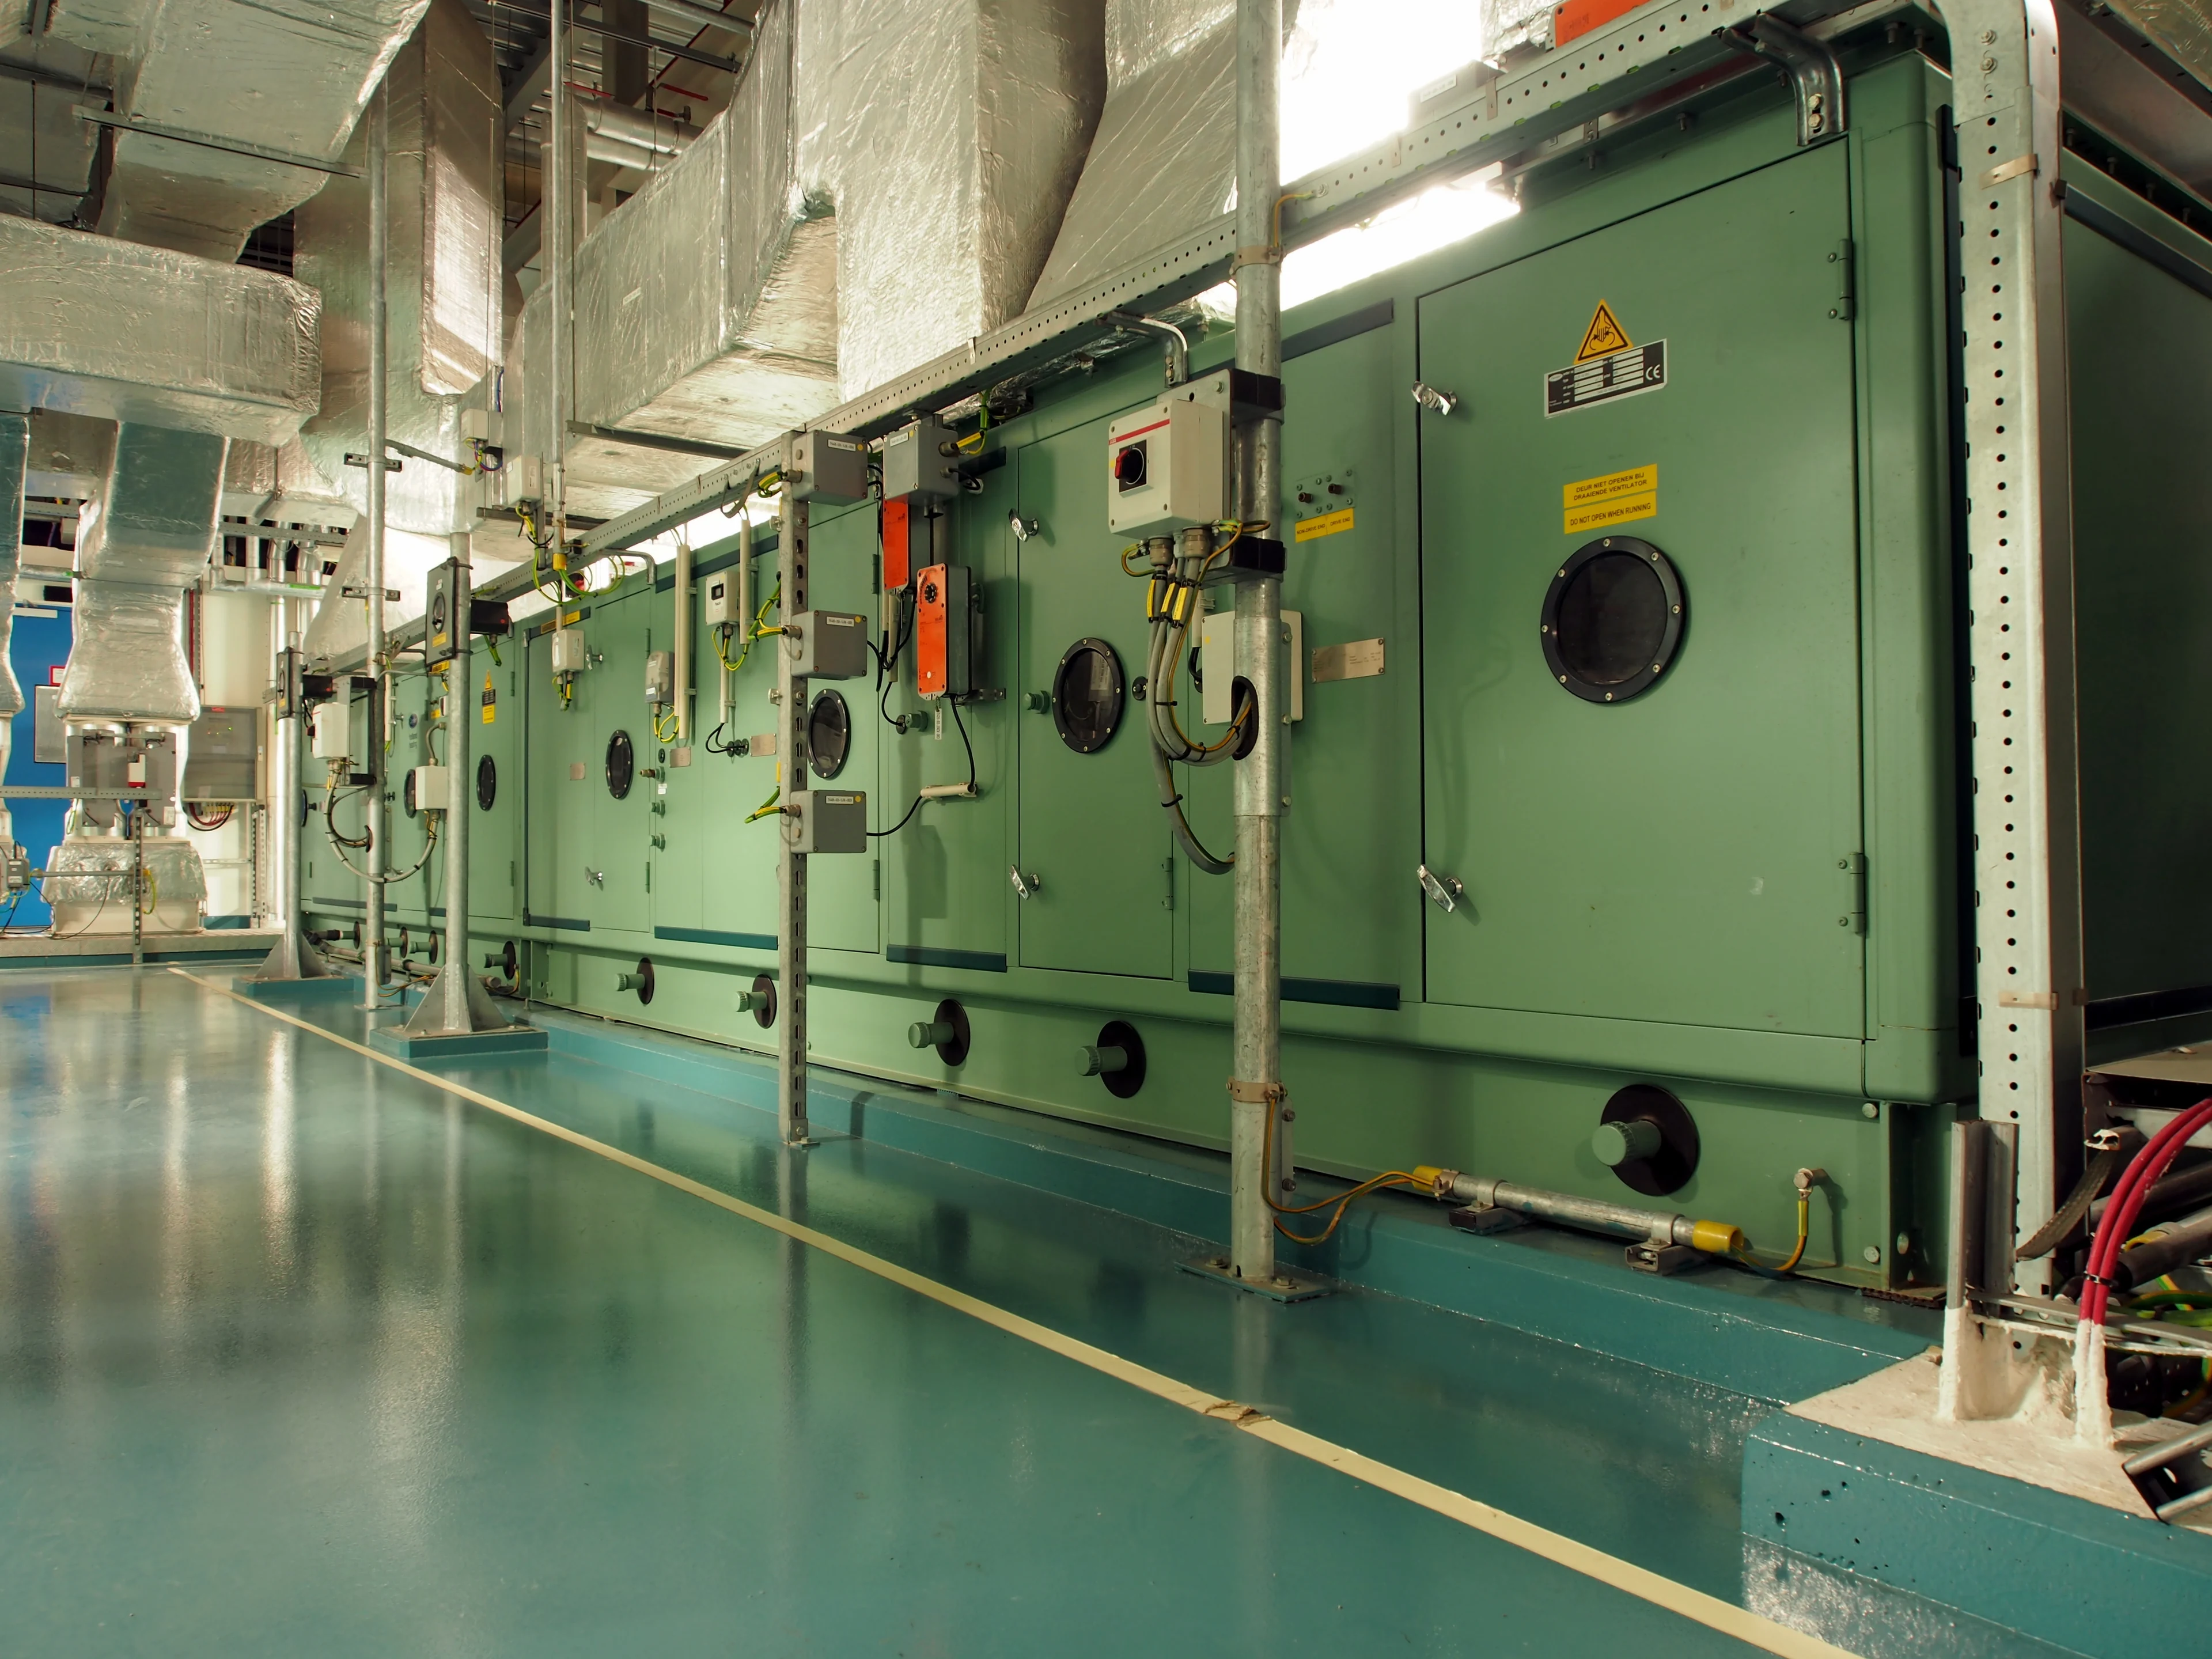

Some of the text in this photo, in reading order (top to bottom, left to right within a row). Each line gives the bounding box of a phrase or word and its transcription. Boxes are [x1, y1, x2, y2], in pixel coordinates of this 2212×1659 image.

[1646, 364, 1660, 380] CE
[1574, 480, 1647, 501] DRAAIENDE VENTILATOR
[1576, 484, 1592, 493] DEUR
[1608, 475, 1634, 485] OPENEN
[1580, 516, 1590, 524] NOT
[1592, 513, 1607, 521] OPEN
[1608, 509, 1624, 518] WHEN
[1626, 503, 1651, 514] RUNNING
[1297, 526, 1317, 535] NON-DRIVE
